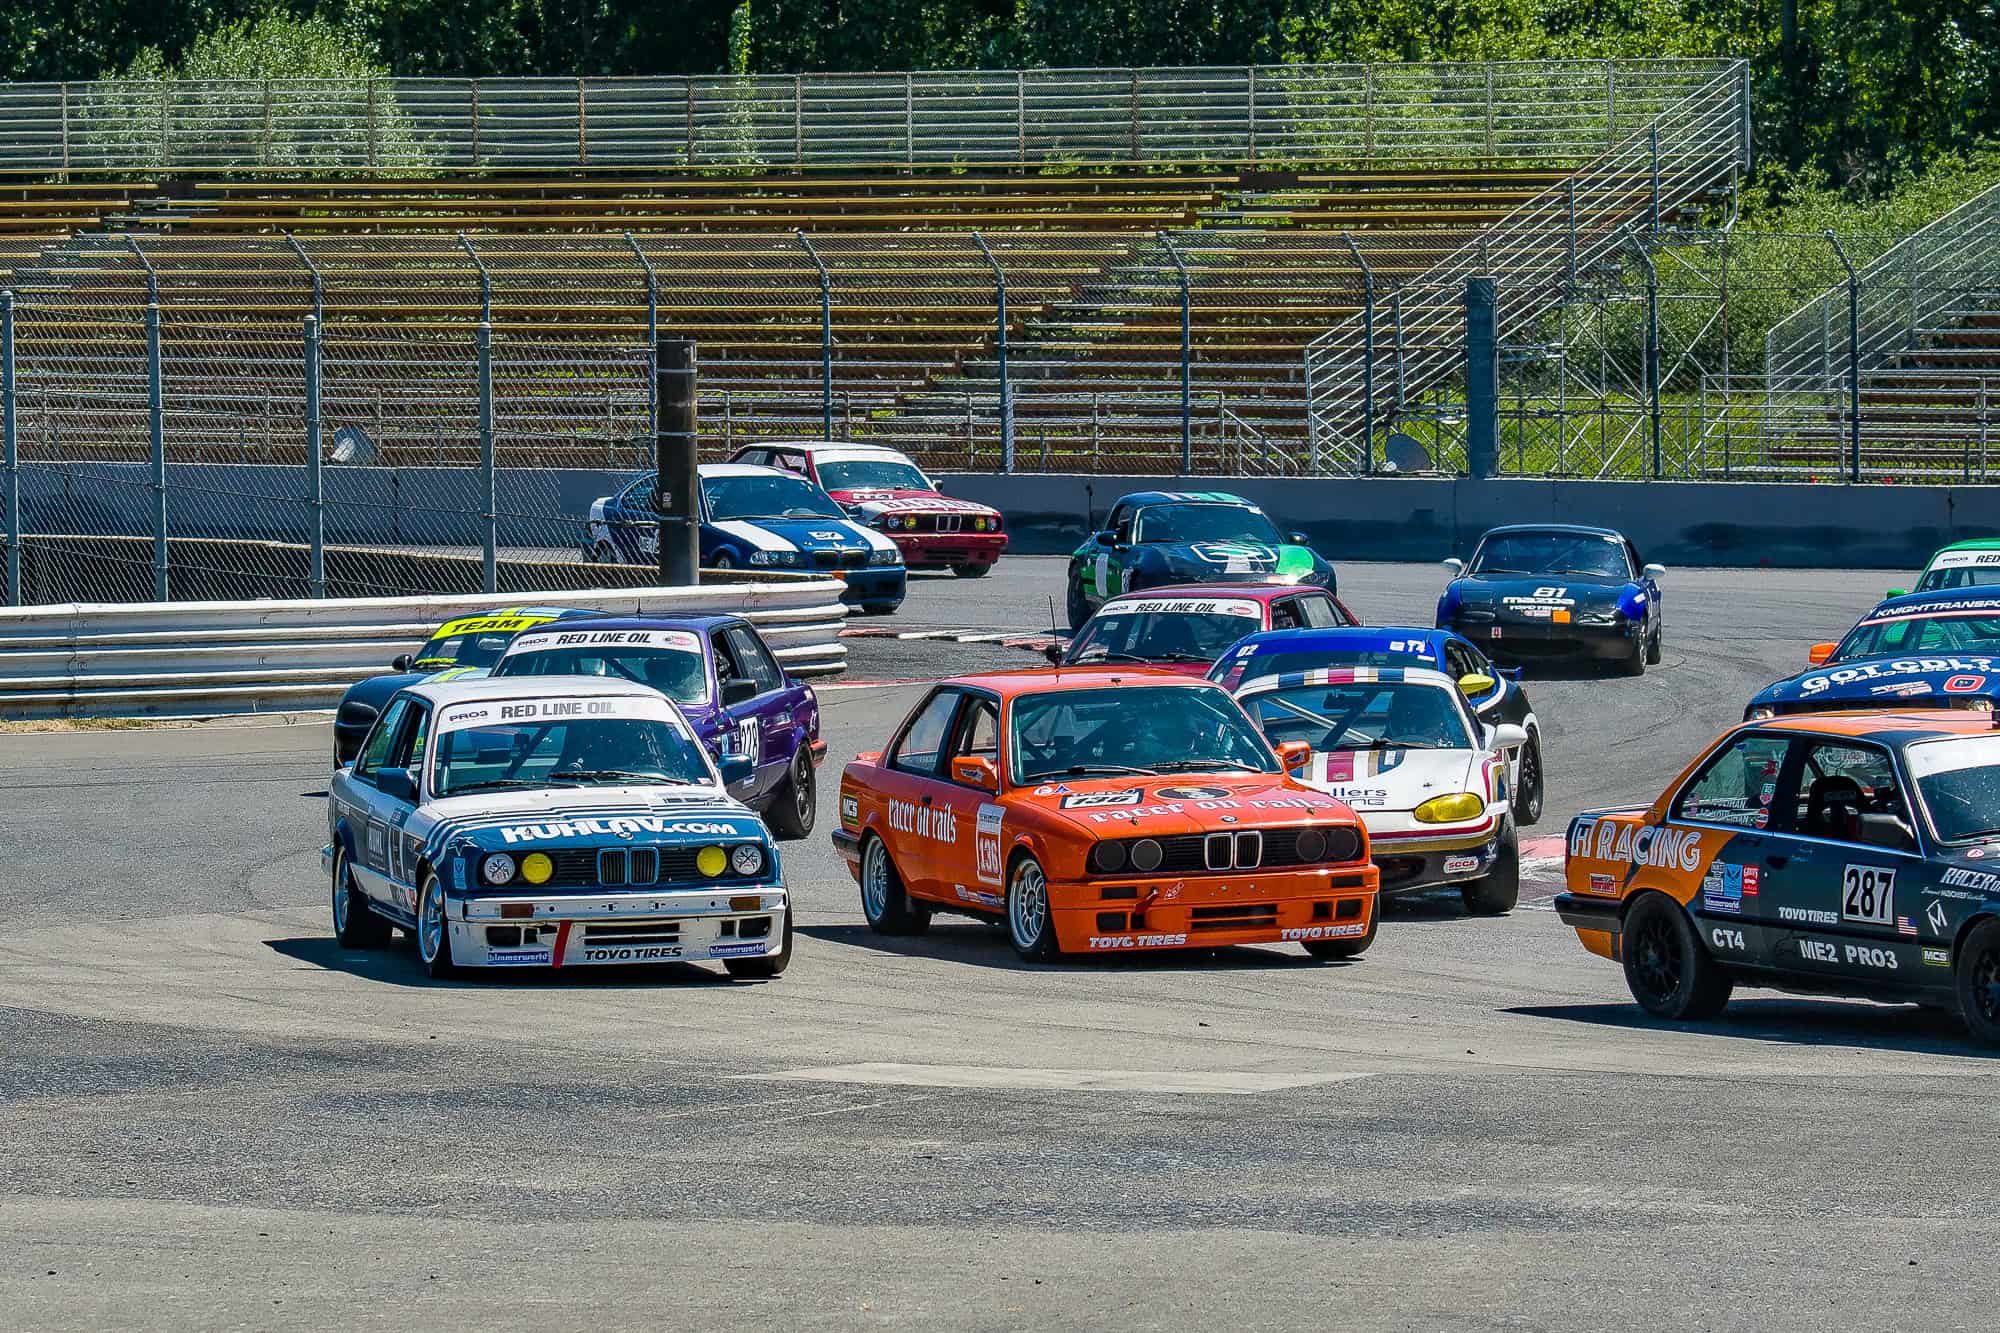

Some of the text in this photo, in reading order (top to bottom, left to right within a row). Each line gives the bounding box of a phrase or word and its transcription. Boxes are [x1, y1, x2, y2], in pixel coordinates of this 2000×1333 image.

[1533, 587, 1568, 597] 81
[1135, 603, 1162, 613] RED
[1162, 602, 1193, 613] LINE
[1194, 602, 1217, 613] OIL
[450, 618, 523, 633] TEAM
[556, 634, 588, 645] RED
[589, 633, 625, 643] LINE
[628, 632, 652, 644] OIL
[449, 702, 616, 722] PRO3 RED LINE OIL
[1196, 799, 1236, 809] on
[1248, 796, 1334, 811] rails
[888, 798, 915, 833] racer
[916, 804, 930, 838] on
[932, 804, 957, 844] rails
[1596, 821, 1702, 871] RACING
[978, 837, 1000, 873] 136
[1940, 867, 1989, 889] RACER
[1845, 868, 1892, 919] 287
[1808, 910, 1838, 924] TIRES
[1324, 923, 1365, 936] TIRES
[1137, 934, 1187, 945] TIRES
[1713, 929, 1745, 950] CT4
[634, 947, 682, 959] TIRES
[1800, 940, 1898, 968] ME2 PRO3
[1924, 951, 1947, 961] MCS
